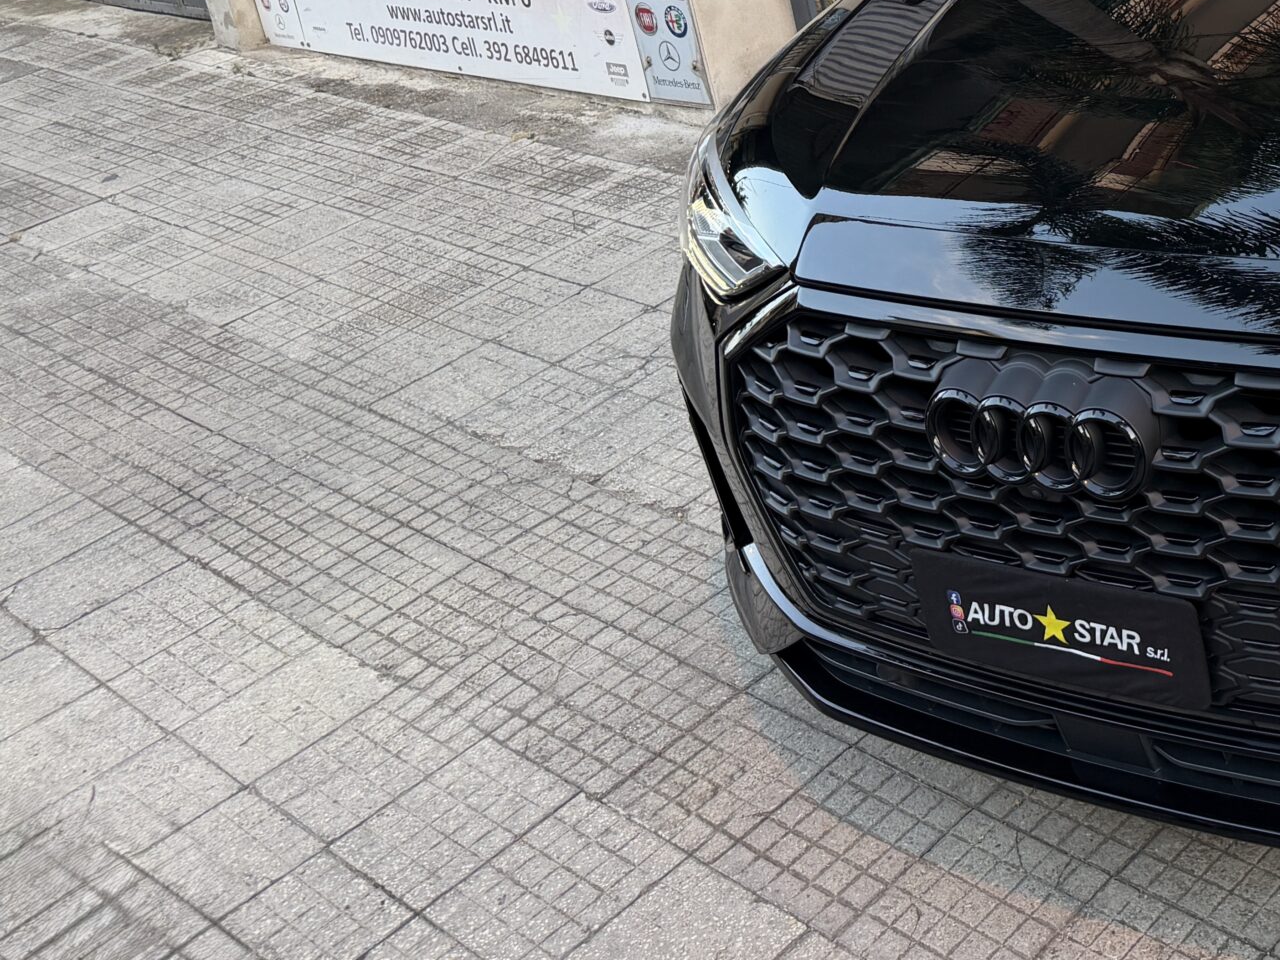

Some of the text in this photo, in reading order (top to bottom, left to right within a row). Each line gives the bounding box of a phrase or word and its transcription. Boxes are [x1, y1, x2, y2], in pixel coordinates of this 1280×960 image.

[387, 5, 513, 34] www.autostarsrl.it
[346, 22, 579, 72] Tel. 0909762003 Cell. 392 6849611
[653, 75, 701, 90] Mercedes-Benz
[967, 602, 1171, 661] AUTO STAR s.r.l.
